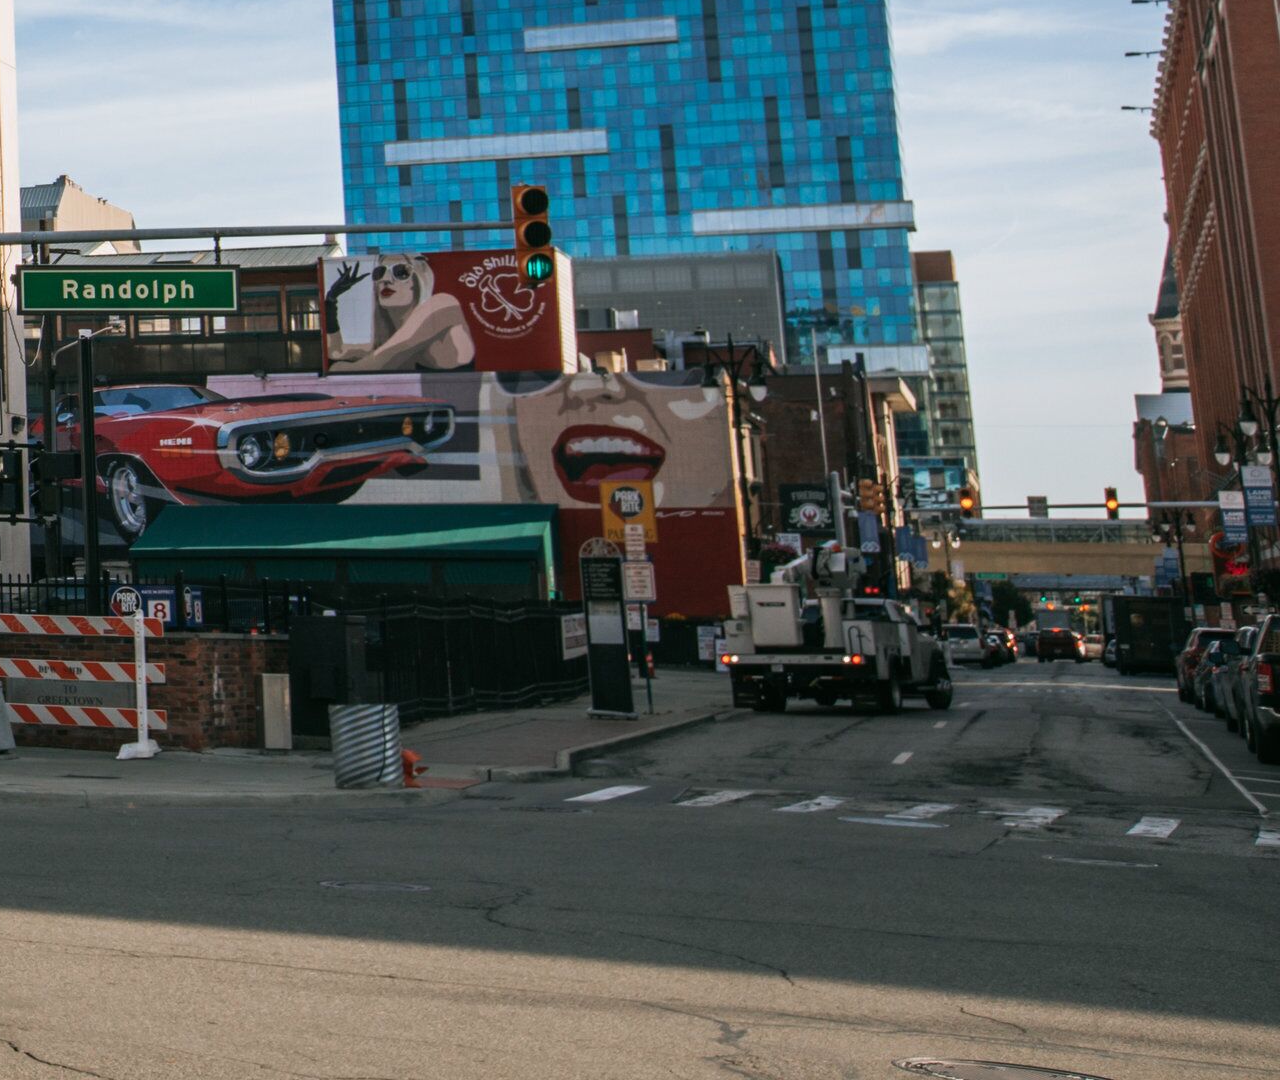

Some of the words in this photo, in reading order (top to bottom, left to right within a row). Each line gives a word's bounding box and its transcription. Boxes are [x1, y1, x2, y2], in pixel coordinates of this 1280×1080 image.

[62, 279, 195, 303] Randolph
[615, 491, 639, 502] PARK
[621, 501, 640, 512] RITE
[116, 592, 137, 602] PARK
[122, 601, 137, 612] RITE
[154, 603, 166, 619] 8
[63, 684, 77, 694] TO
[37, 695, 103, 706] GREEKTOWN
